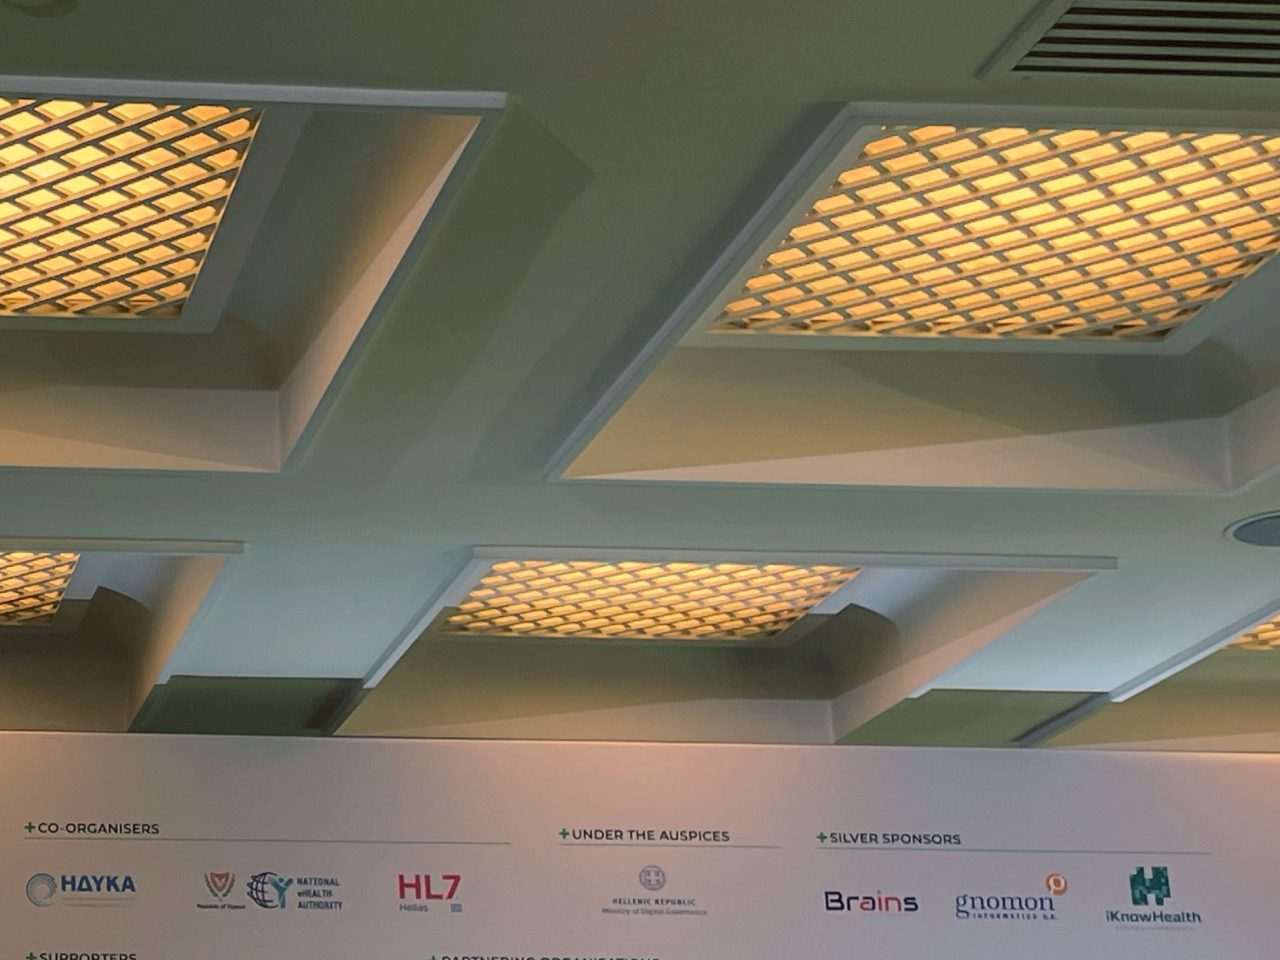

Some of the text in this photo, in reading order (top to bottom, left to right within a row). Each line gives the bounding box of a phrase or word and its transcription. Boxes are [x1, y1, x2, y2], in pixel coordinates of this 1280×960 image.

[38, 822, 160, 835] CO-ORGANISERS
[572, 829, 731, 843] UNDER THE AUSPICES
[830, 832, 962, 846] SILVER SPONSORS
[297, 877, 341, 886] NATIONAL
[398, 874, 462, 900] HL7
[298, 901, 343, 911] AUTHORITY
[399, 903, 429, 912] Hellas
[825, 890, 919, 913] Brains
[955, 894, 1056, 920] gnomon
[1106, 910, 1202, 923] iKnowHealth
